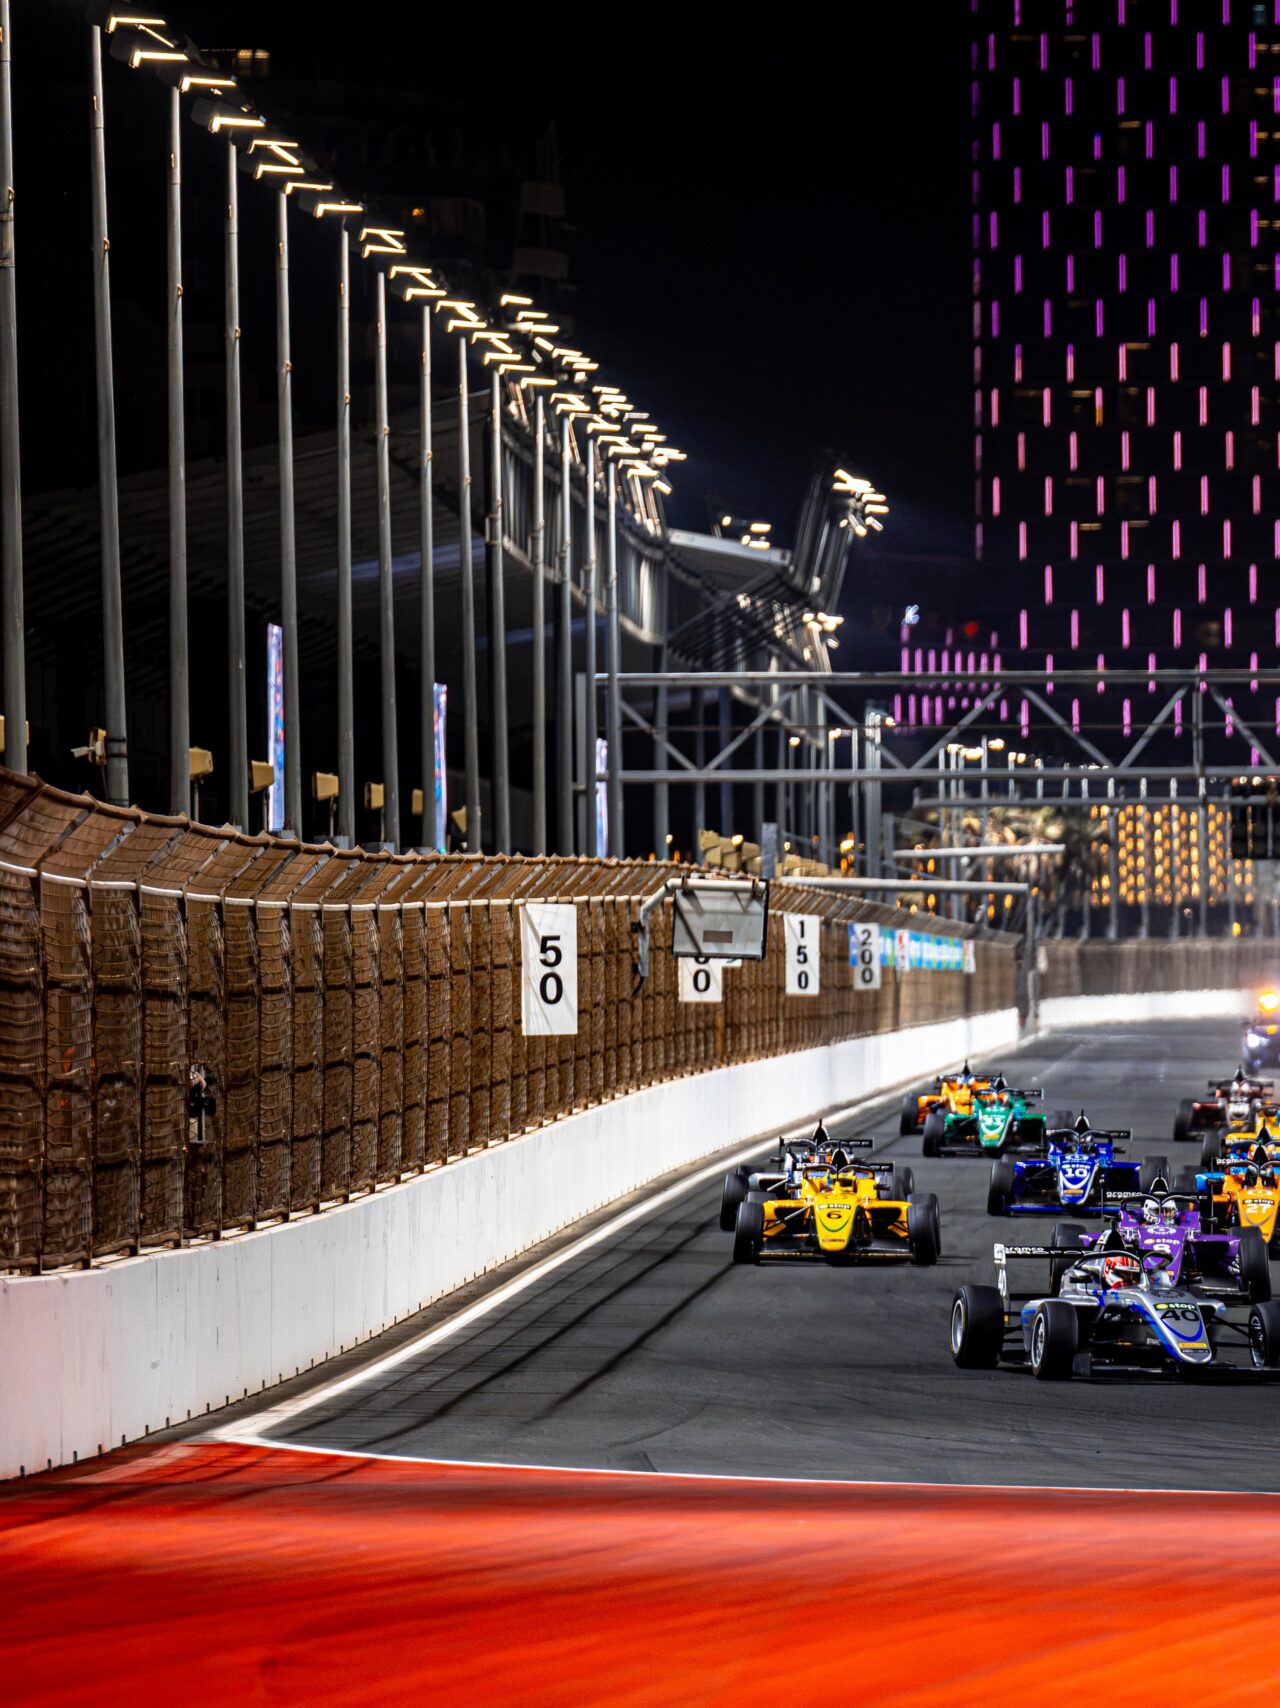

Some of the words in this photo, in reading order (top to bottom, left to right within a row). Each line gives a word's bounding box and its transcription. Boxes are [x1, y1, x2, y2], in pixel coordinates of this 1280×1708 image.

[796, 920, 809, 990] 150
[860, 929, 873, 984] 200
[539, 935, 563, 1005] 50
[1064, 1167, 1088, 1178] 10
[826, 1210, 842, 1220] 6
[1245, 1204, 1272, 1214] 27
[1168, 1302, 1196, 1310] stop
[1160, 1309, 1200, 1322] 40
